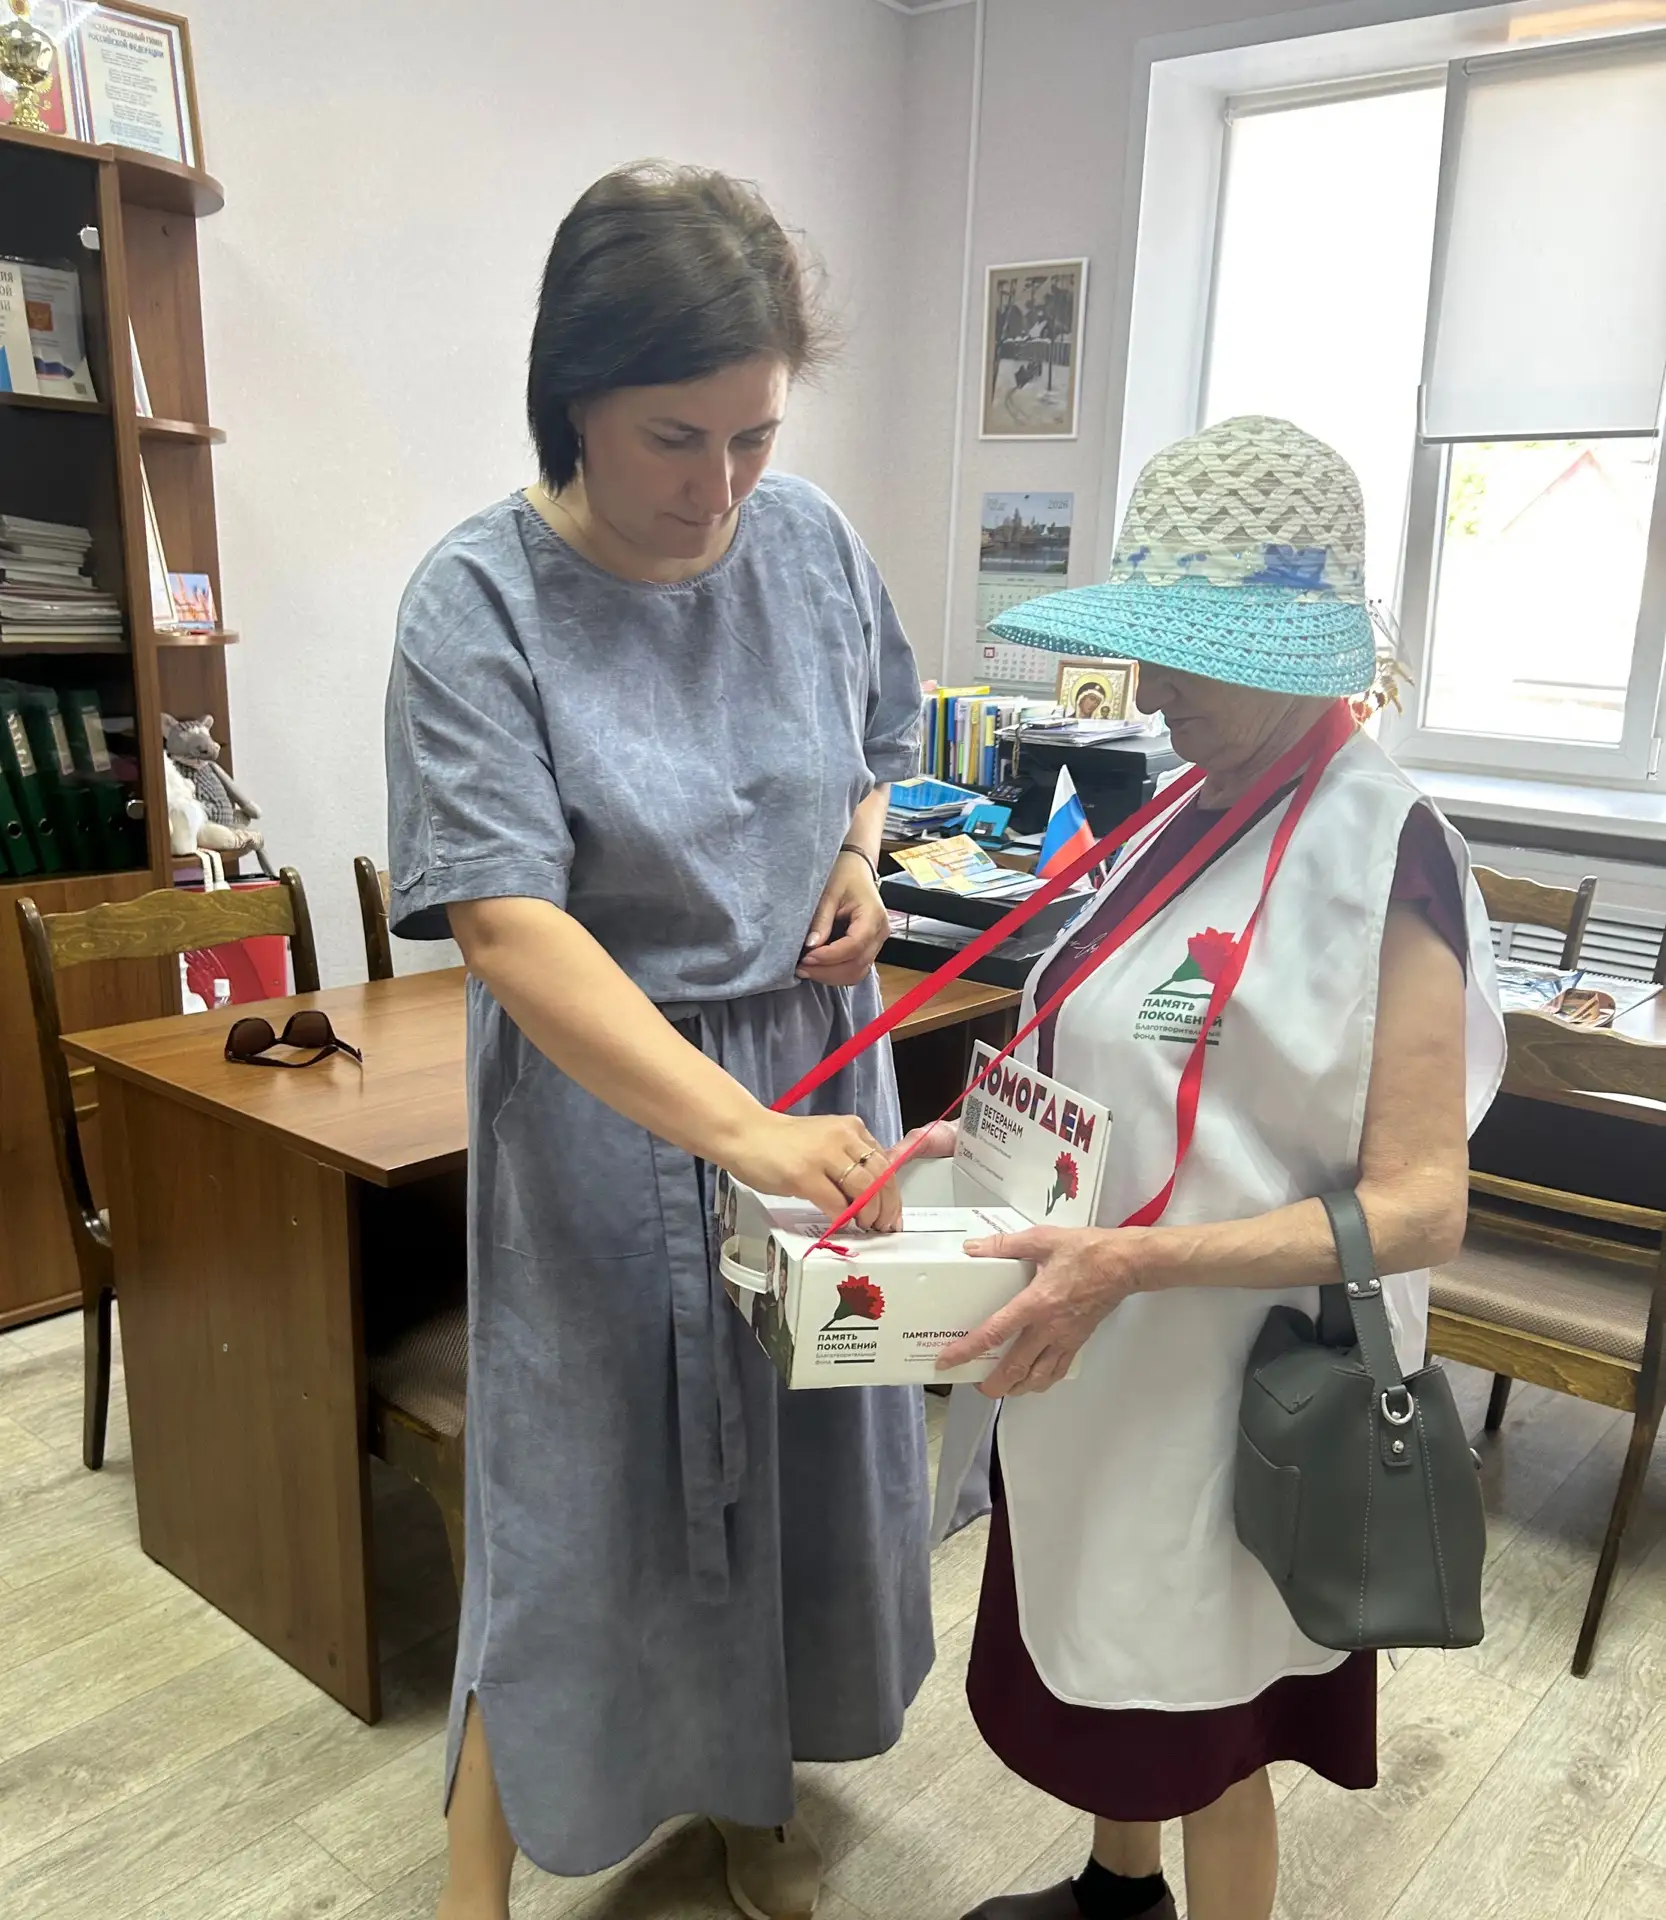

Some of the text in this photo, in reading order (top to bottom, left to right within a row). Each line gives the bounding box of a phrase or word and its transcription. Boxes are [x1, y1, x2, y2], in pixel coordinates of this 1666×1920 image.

[1143, 998, 1195, 1011] ПАМЯТЬ
[1138, 1010, 1222, 1028] ПОКОЛЕНЙ
[972, 1051, 1096, 1153] ПОМОГАЕМ
[983, 1104, 1023, 1138] ВЕТЕРАНАМ
[981, 1119, 1007, 1144] ВМЕСТЕ
[817, 1341, 877, 1351] ПОКОЛЕНИЙ
[818, 1333, 858, 1342] ПАМЯТЬ
